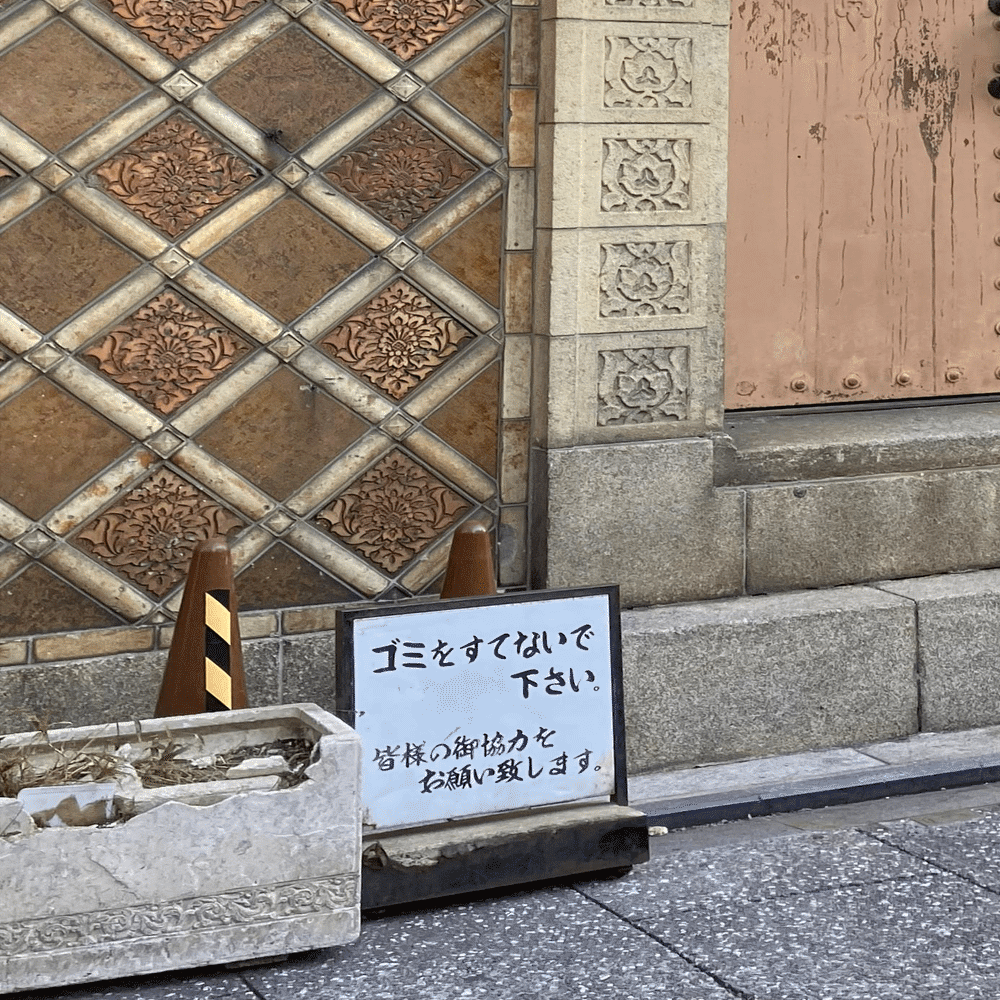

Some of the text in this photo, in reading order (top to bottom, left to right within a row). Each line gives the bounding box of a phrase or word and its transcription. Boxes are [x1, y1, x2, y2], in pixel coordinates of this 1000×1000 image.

[372, 624, 595, 673] ゴミをすてないで
[510, 667, 600, 699] 下さい。
[372, 726, 556, 772] 皆様の御協力を
[418, 748, 602, 793] お願い致します。
